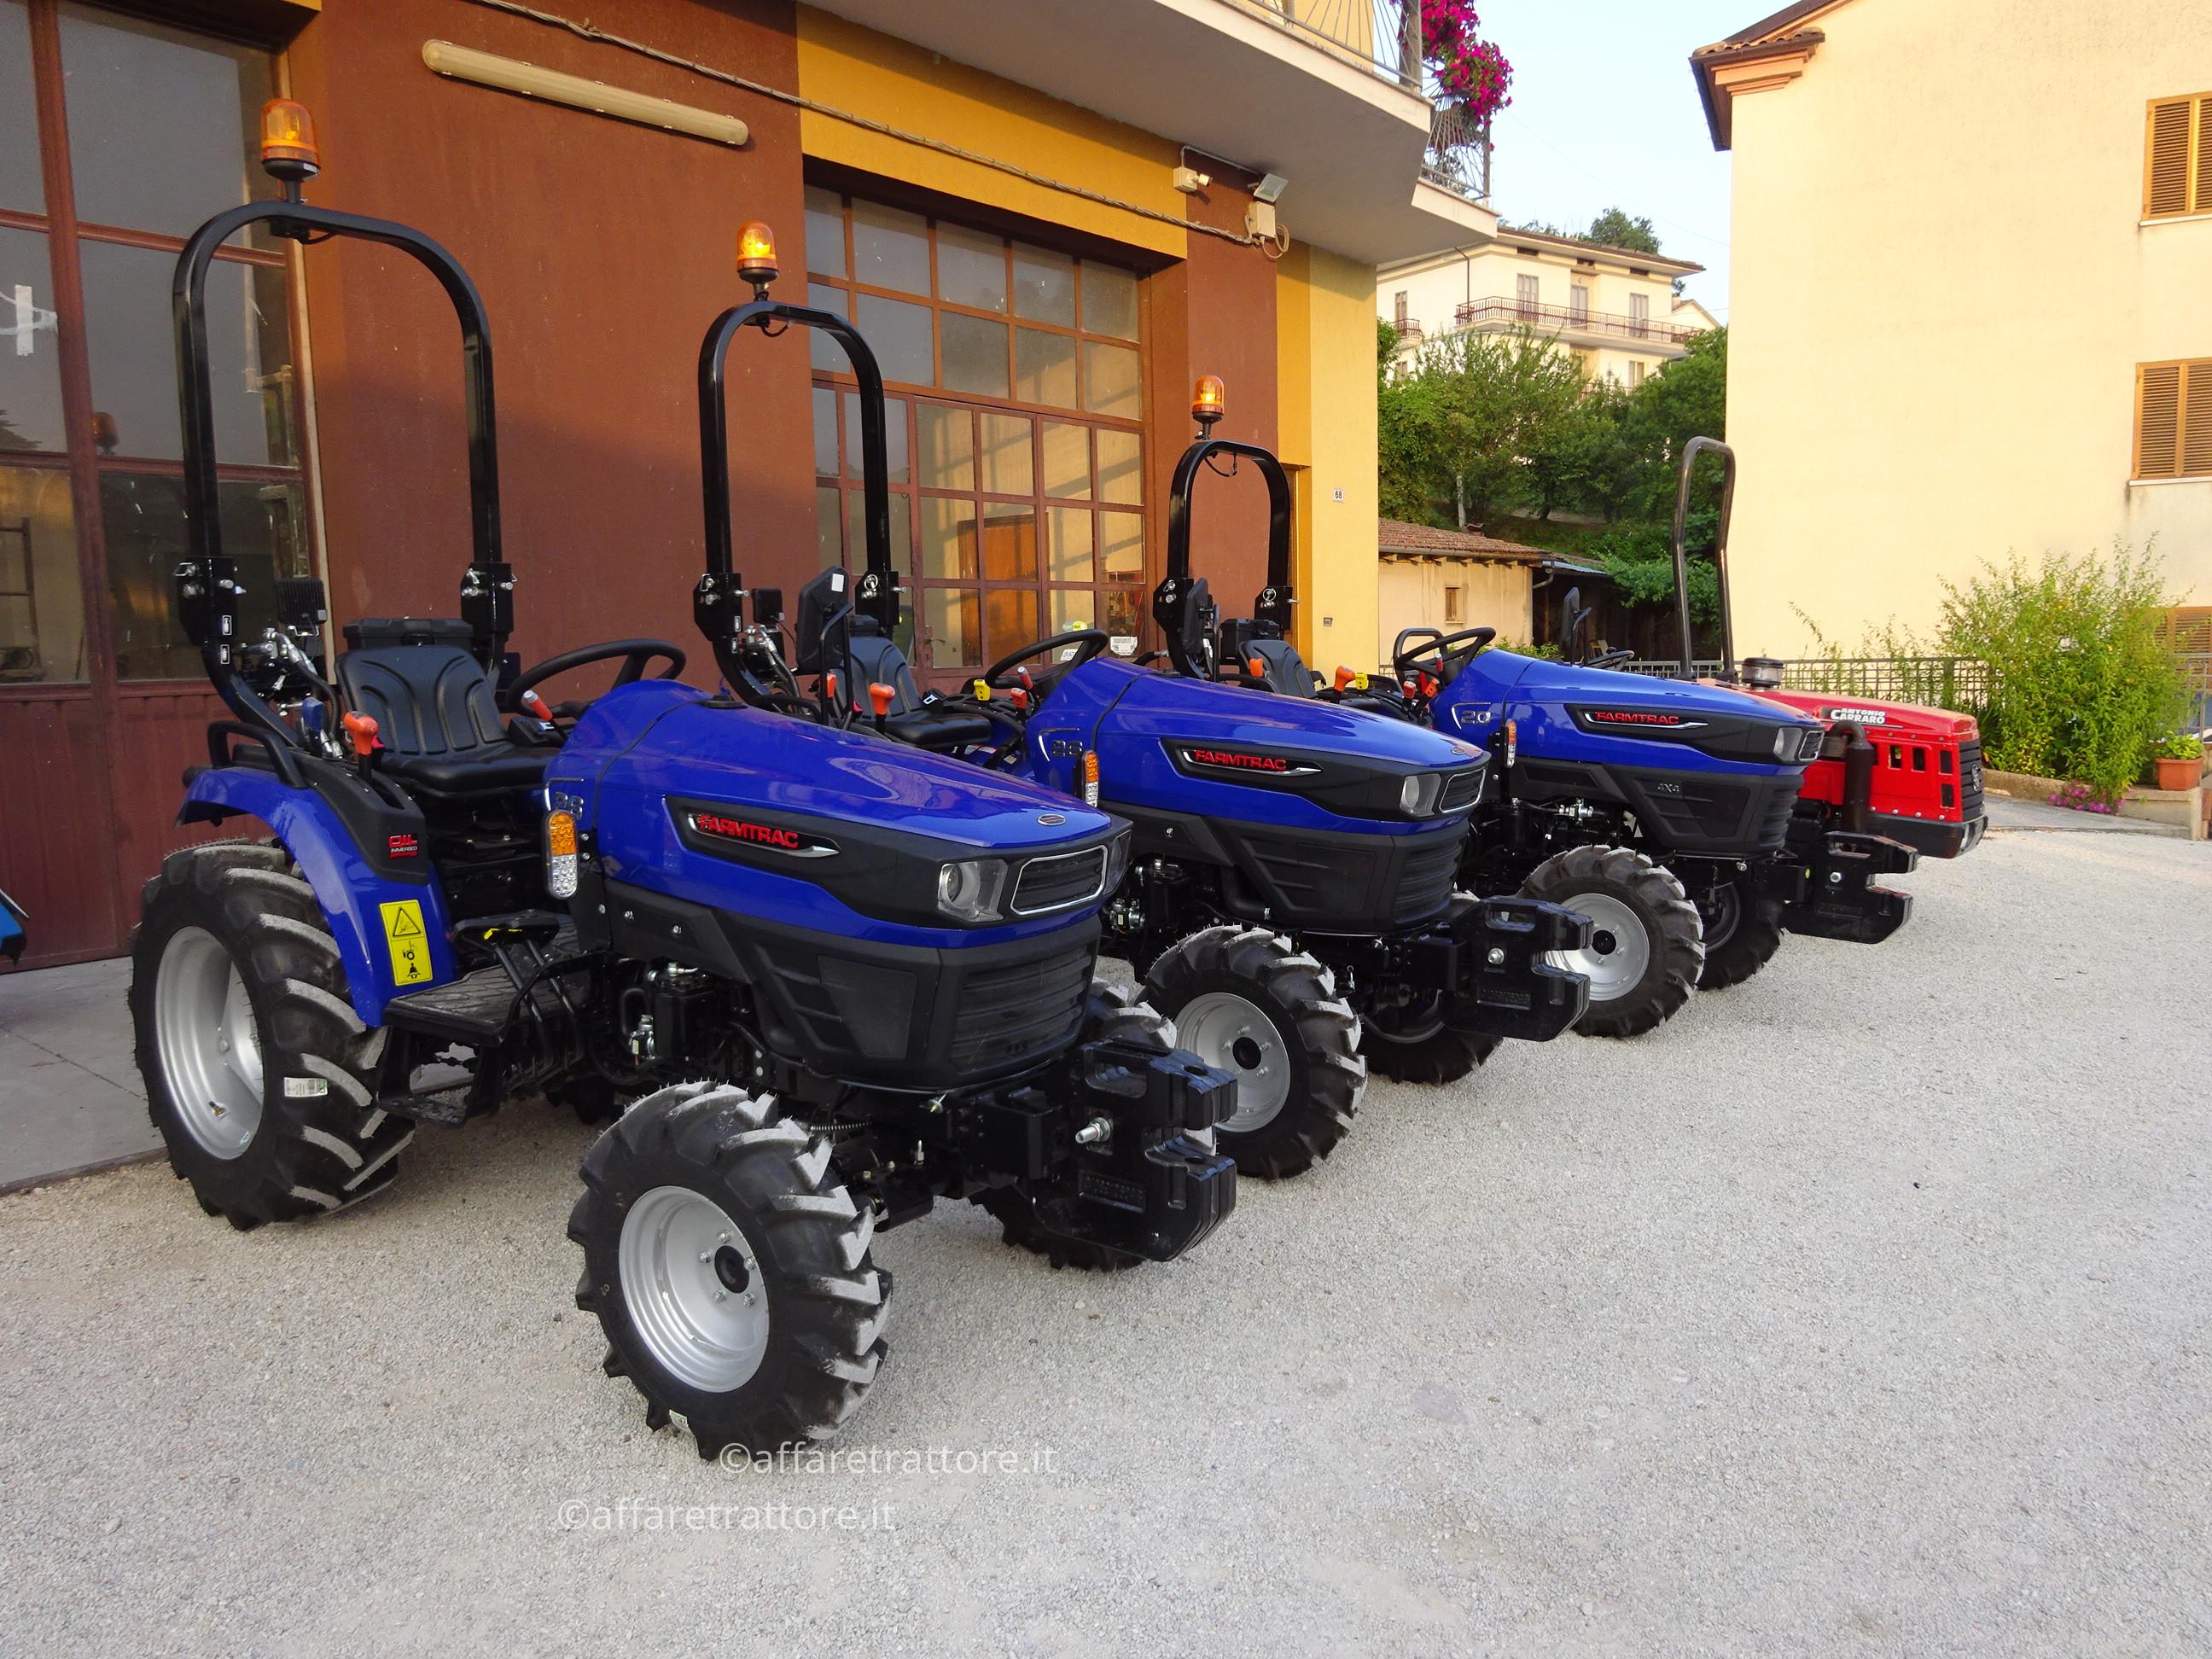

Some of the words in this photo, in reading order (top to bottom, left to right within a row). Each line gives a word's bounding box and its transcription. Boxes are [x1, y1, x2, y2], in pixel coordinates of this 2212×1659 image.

[1335, 490, 1342, 499] 68
[1461, 710, 1491, 725] 20
[1596, 712, 1679, 725] FARMTRAC
[1830, 709, 1886, 725] CARRARO
[1840, 708, 1886, 717] ANTONIO
[1051, 740, 1083, 757] 26
[1194, 749, 1287, 771] FARMTRAC
[698, 813, 799, 849] FARMTRAC
[389, 834, 418, 848] OIL
